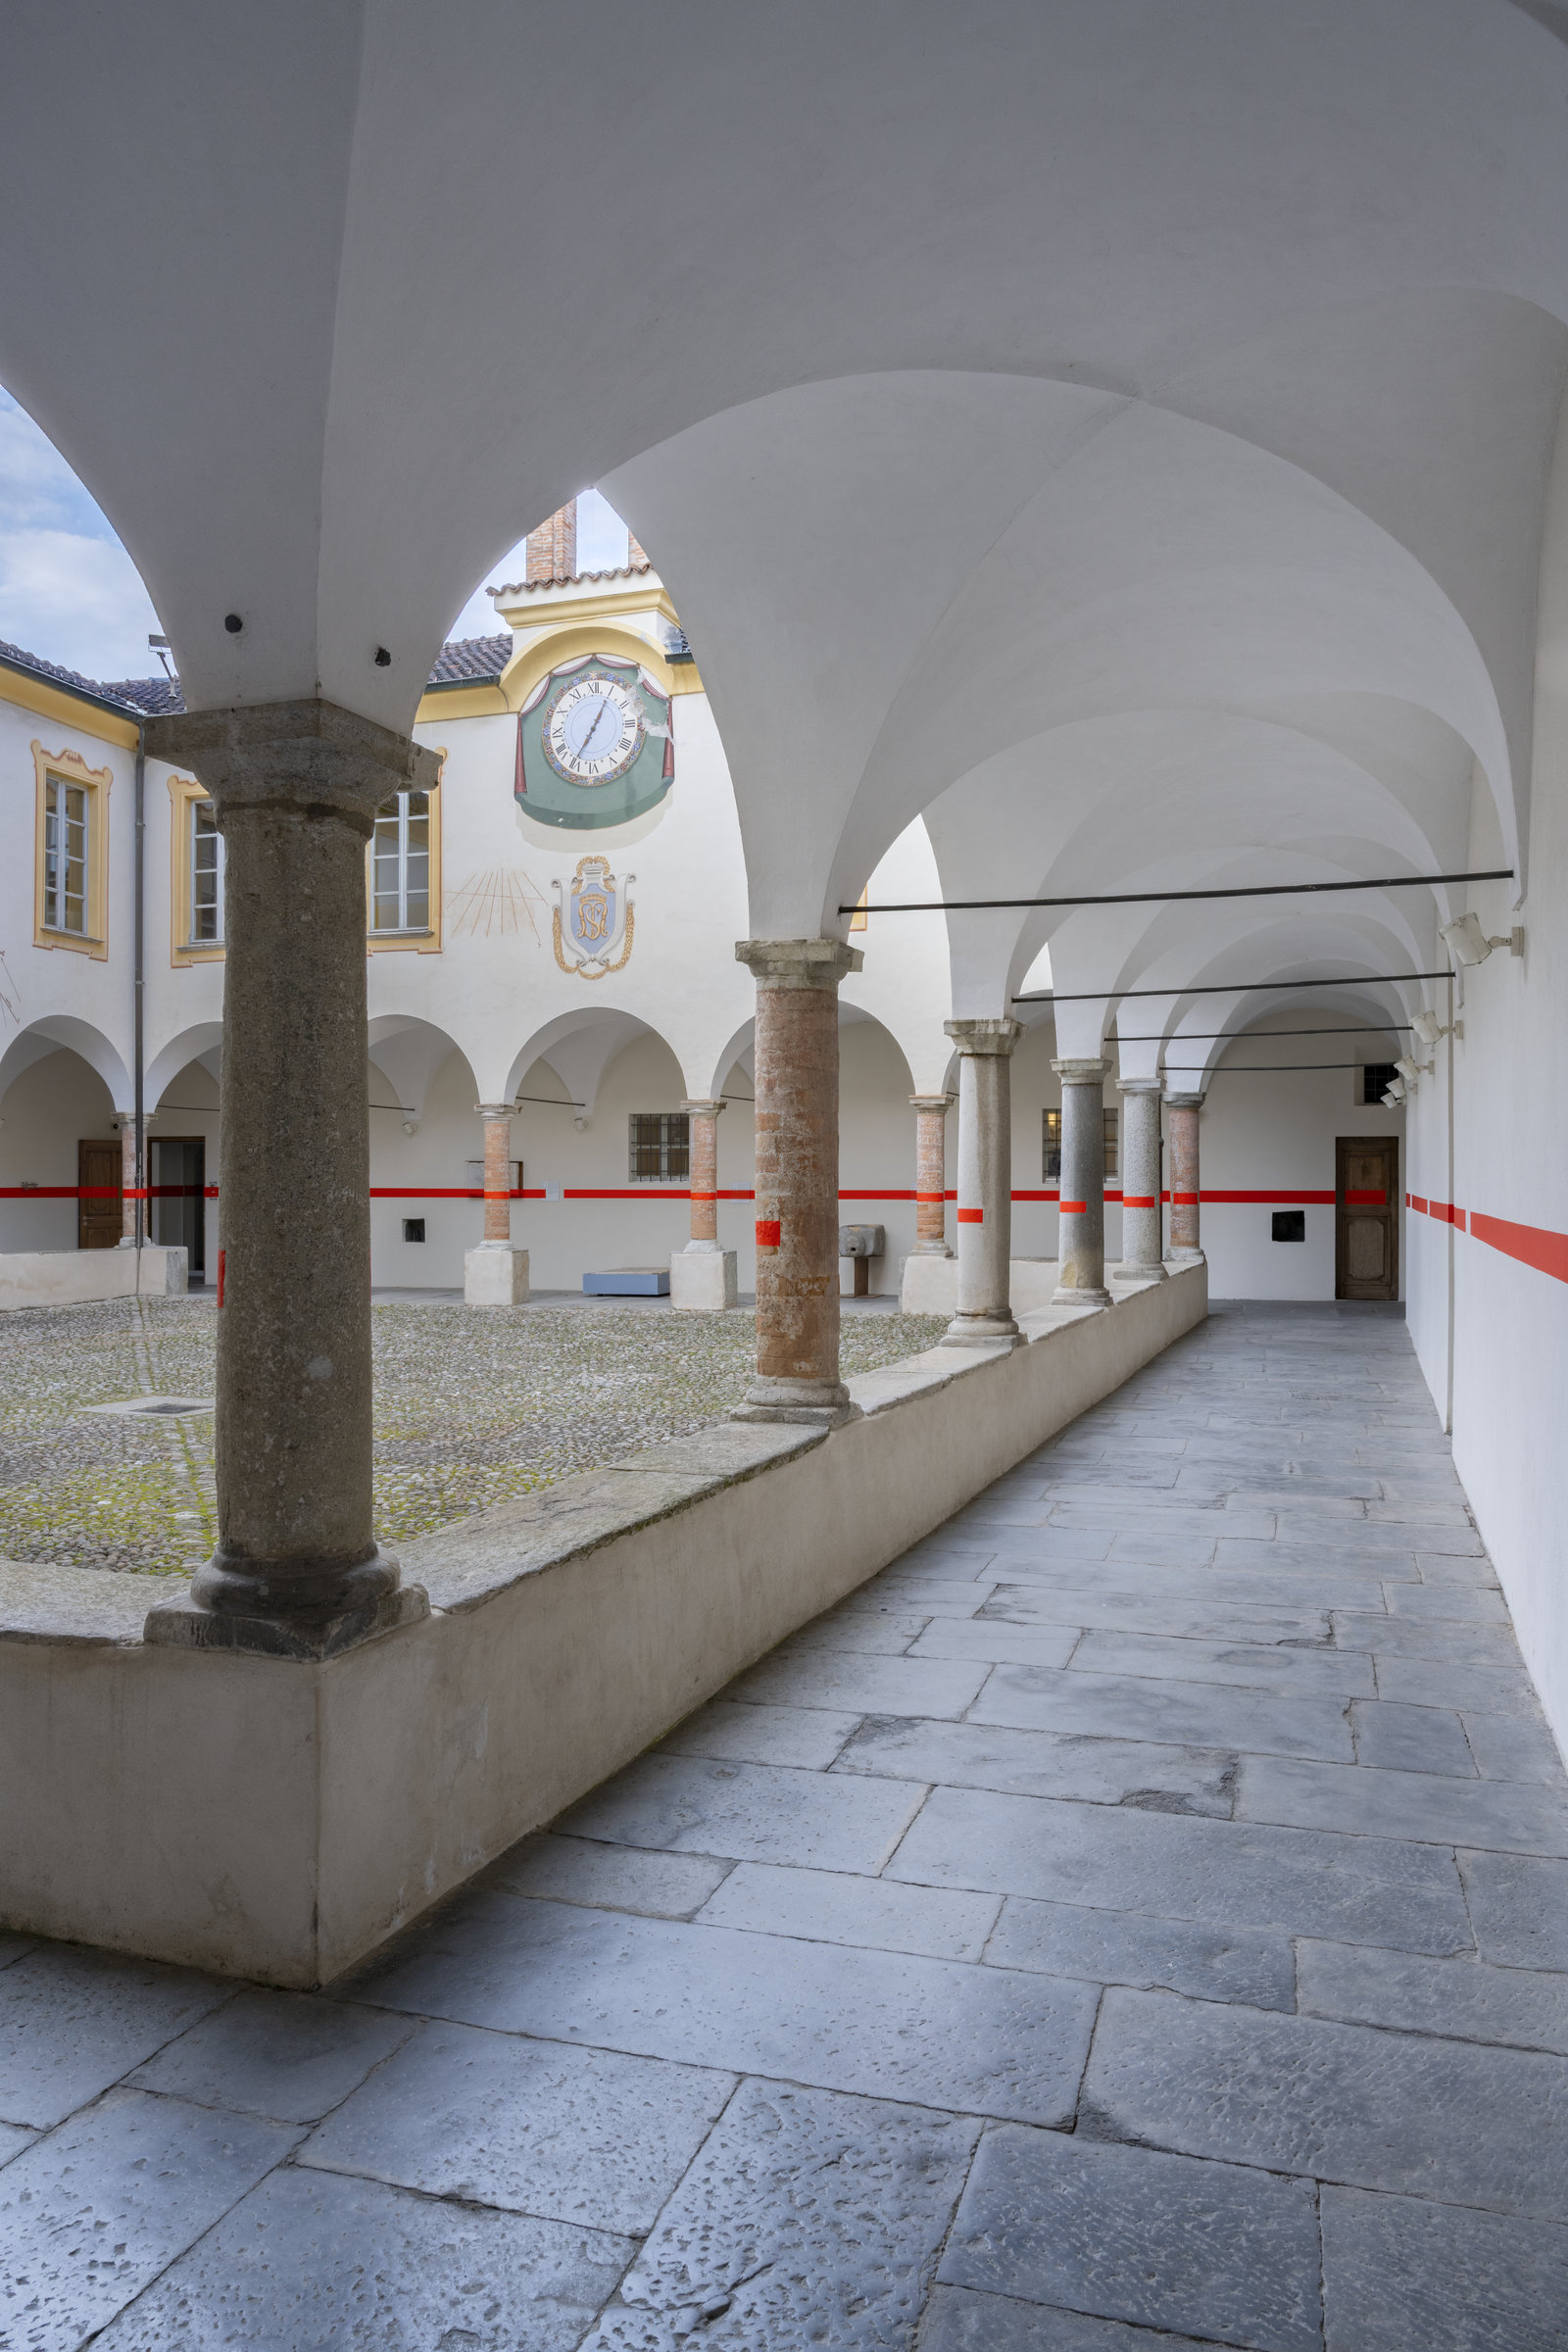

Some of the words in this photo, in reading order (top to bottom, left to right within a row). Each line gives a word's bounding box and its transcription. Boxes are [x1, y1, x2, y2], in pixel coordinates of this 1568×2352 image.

[588, 681, 599, 694] XII
[609, 686, 614, 696] I
[569, 688, 581, 703] XI
[556, 706, 568, 718] X
[625, 719, 636, 728] III
[553, 727, 563, 738] IX
[619, 737, 632, 751] IIII
[569, 757, 581, 772] VII
[589, 762, 599, 774] VI
[609, 757, 618, 767] V
